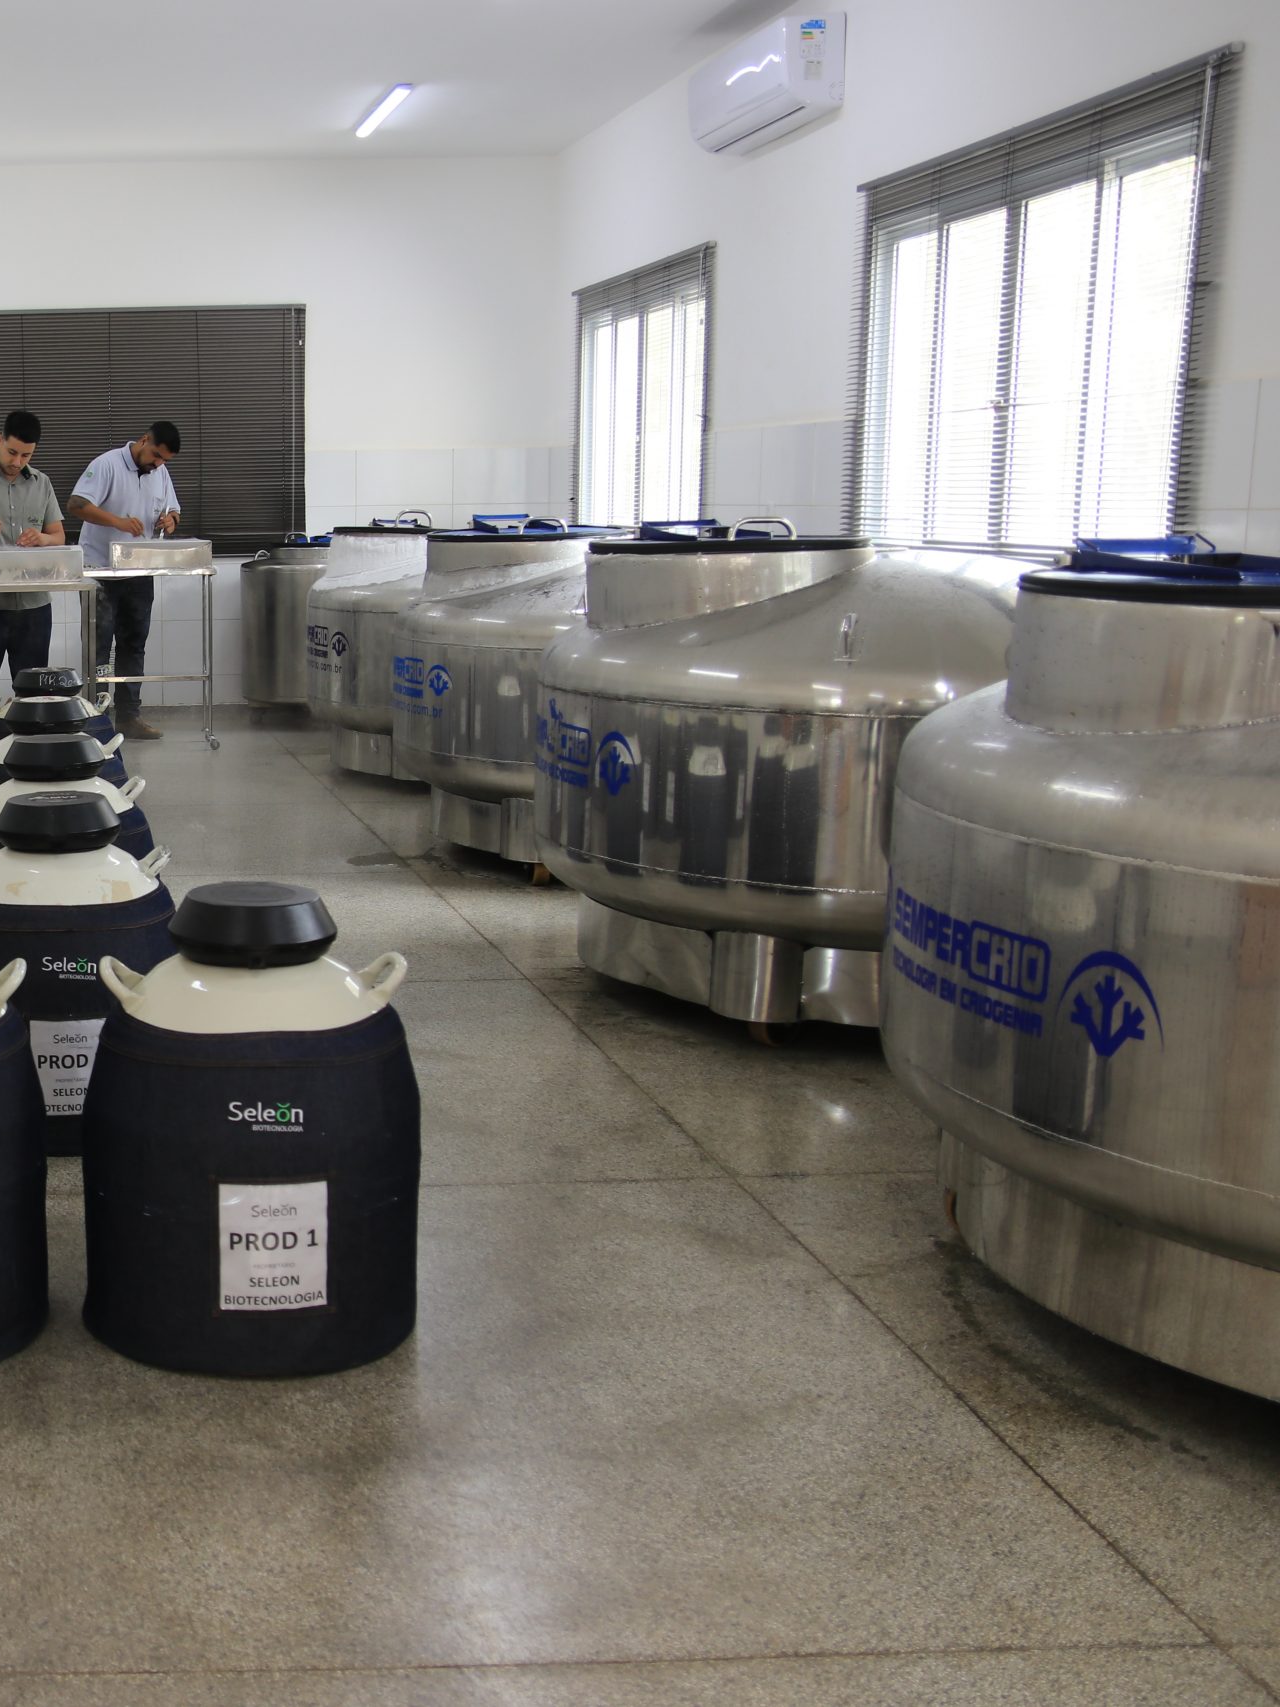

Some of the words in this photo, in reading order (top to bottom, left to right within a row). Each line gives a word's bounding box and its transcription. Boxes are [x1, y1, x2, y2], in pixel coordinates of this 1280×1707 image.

[960, 986, 1044, 1038] CRIOGENIA
[37, 1053, 89, 1070] PROD
[252, 1124, 304, 1133] BIOTECNOLOGIA
[229, 1231, 298, 1251] PROD
[306, 1228, 319, 1248] 1
[249, 1275, 300, 1288] SELEON
[224, 1290, 324, 1306] BIOTECNOLOGIA
